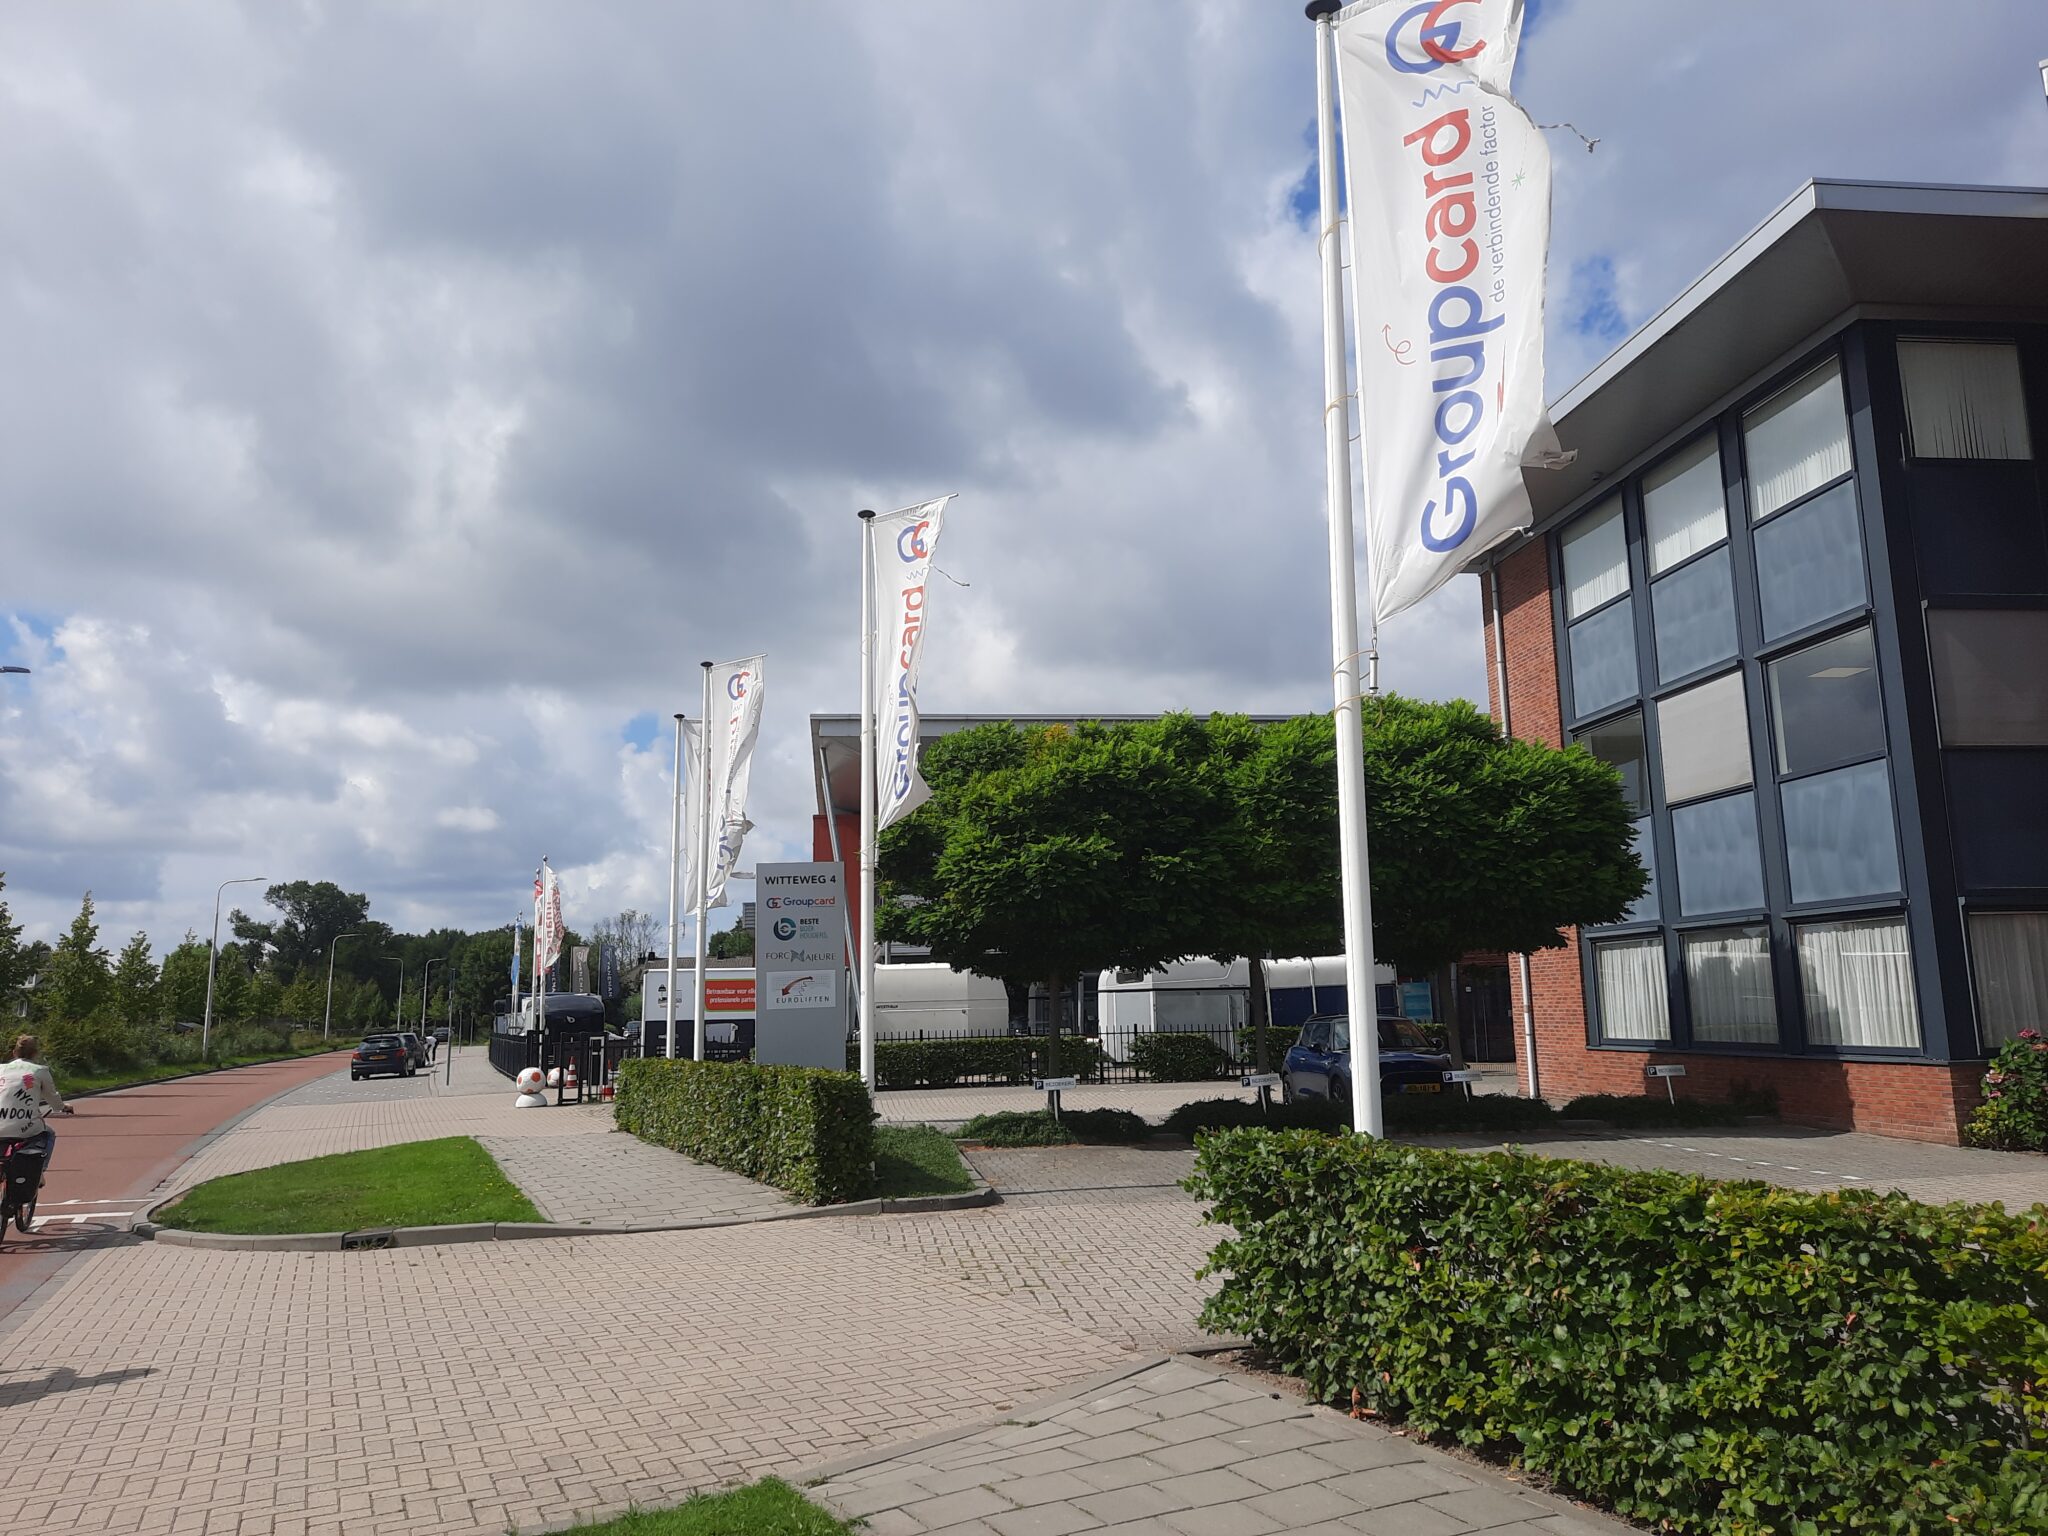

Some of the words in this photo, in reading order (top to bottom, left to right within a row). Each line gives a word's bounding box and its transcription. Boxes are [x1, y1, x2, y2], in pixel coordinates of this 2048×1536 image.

[1479, 105, 1499, 157] factor
[1481, 161, 1505, 275] verbindende
[1488, 278, 1505, 303] de
[1403, 107, 1506, 553] Groupcard
[764, 875, 827, 885] WITTEWEG
[829, 875, 837, 884] 4
[782, 896, 836, 908] Groupcard
[776, 996, 830, 1004] EUROLIFTEN
[13, 1087, 34, 1107] NYC
